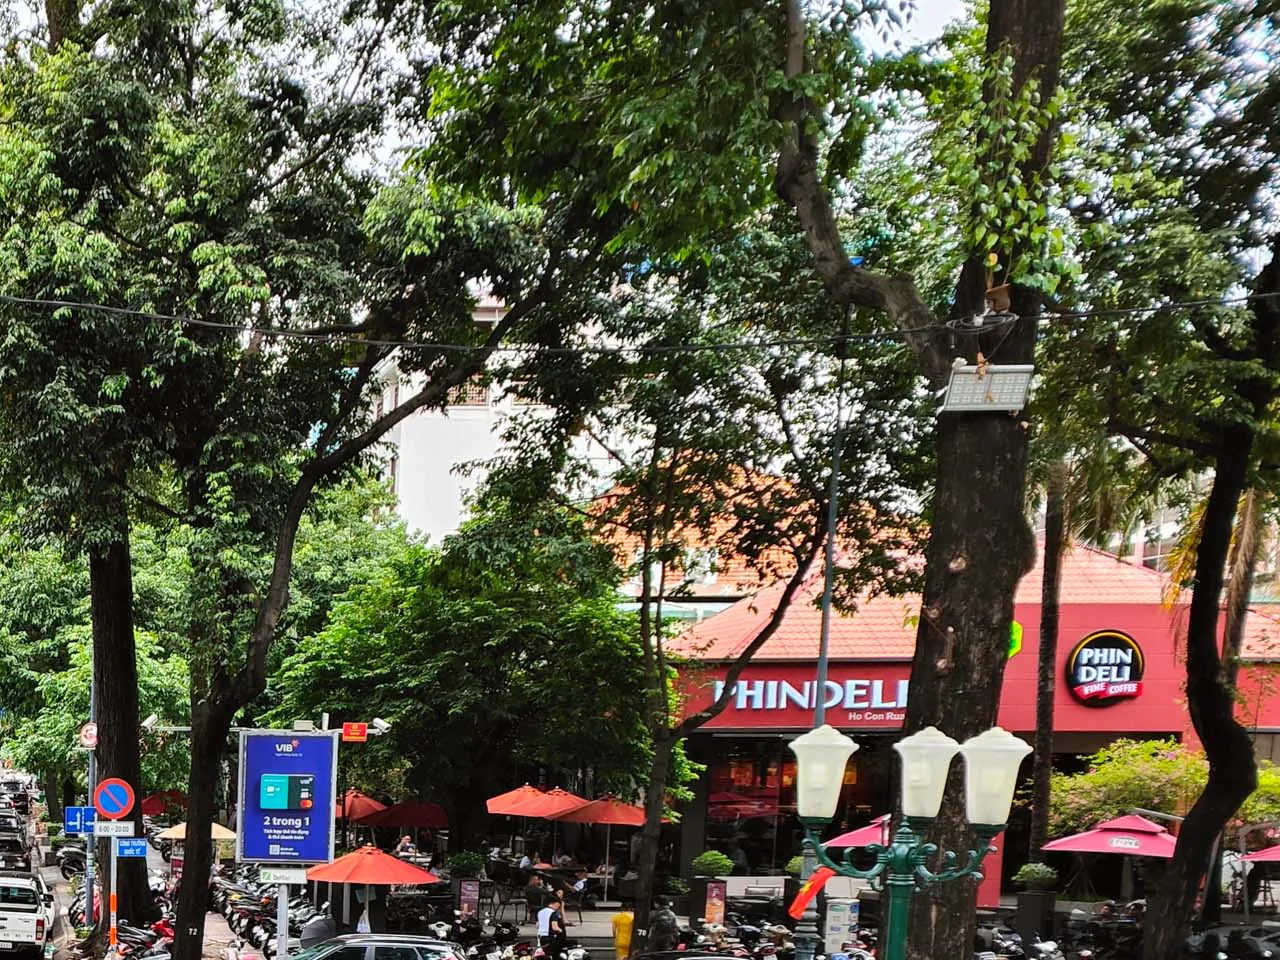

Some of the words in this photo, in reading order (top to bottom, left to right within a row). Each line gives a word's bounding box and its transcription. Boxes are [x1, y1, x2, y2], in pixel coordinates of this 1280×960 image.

[1081, 648, 1132, 664] PHIN
[1079, 666, 1131, 682] DELI
[1108, 683, 1138, 694] COFFEE
[848, 712, 862, 720] Ho
[864, 712, 885, 720] Con
[275, 744, 293, 752] VIB
[263, 816, 270, 826] 2
[272, 817, 302, 828] trong
[304, 817, 310, 826] 1
